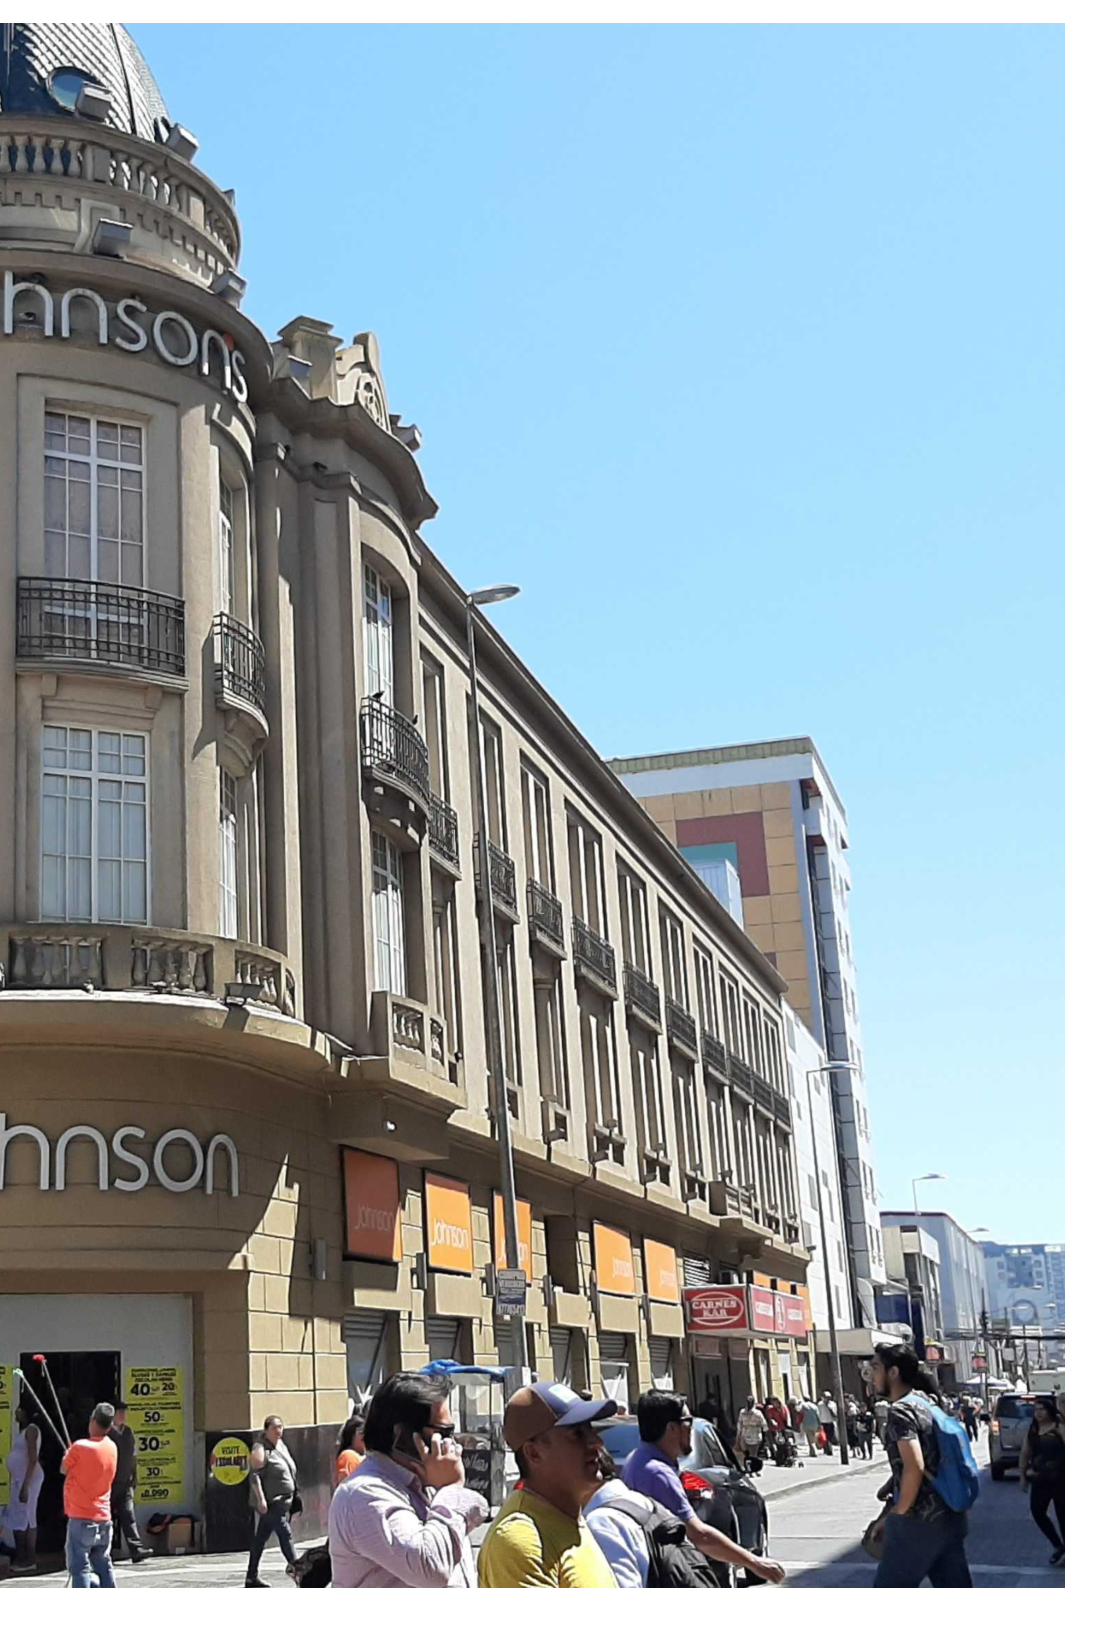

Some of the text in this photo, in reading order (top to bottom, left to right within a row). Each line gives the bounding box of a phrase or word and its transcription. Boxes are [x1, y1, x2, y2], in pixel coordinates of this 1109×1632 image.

[431, 1216, 470, 1250] Johnson
[692, 1299, 738, 1310] CARNES
[702, 1309, 728, 1317] KAR
[130, 1382, 176, 1396] 40 20
[143, 1411, 161, 1423] 50
[138, 1436, 160, 1452] 30
[146, 1466, 161, 1477] 30
